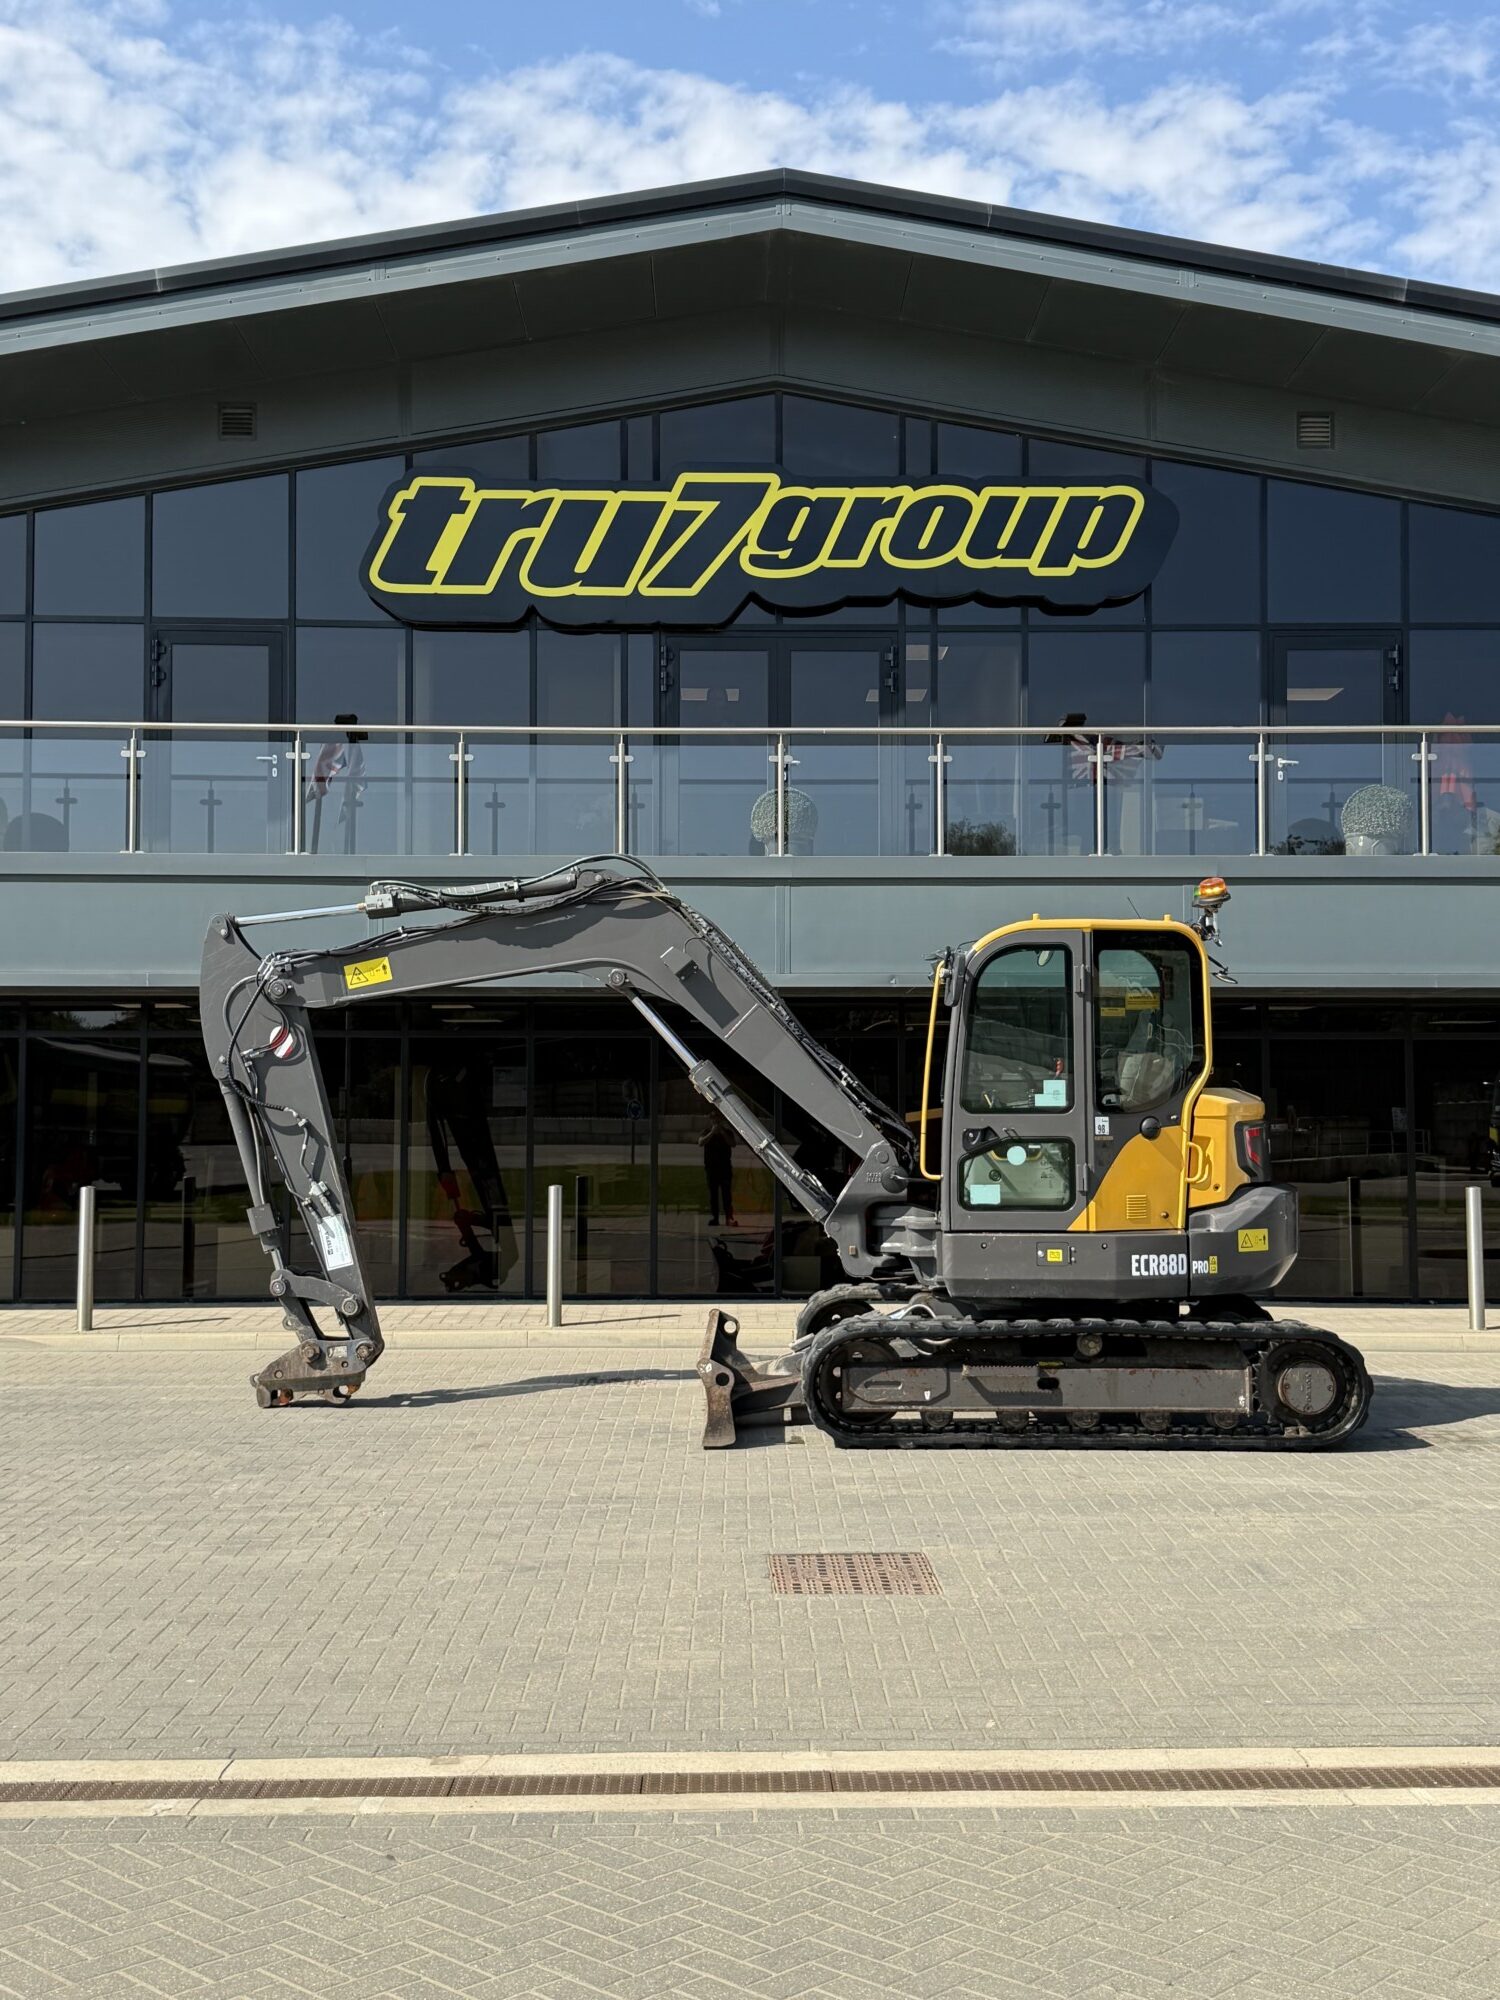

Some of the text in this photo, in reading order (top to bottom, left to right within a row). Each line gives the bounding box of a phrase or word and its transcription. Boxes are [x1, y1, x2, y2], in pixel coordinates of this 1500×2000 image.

[1097, 1124, 1106, 1134] 98
[1131, 1253, 1209, 1276] ECR88D PRO
